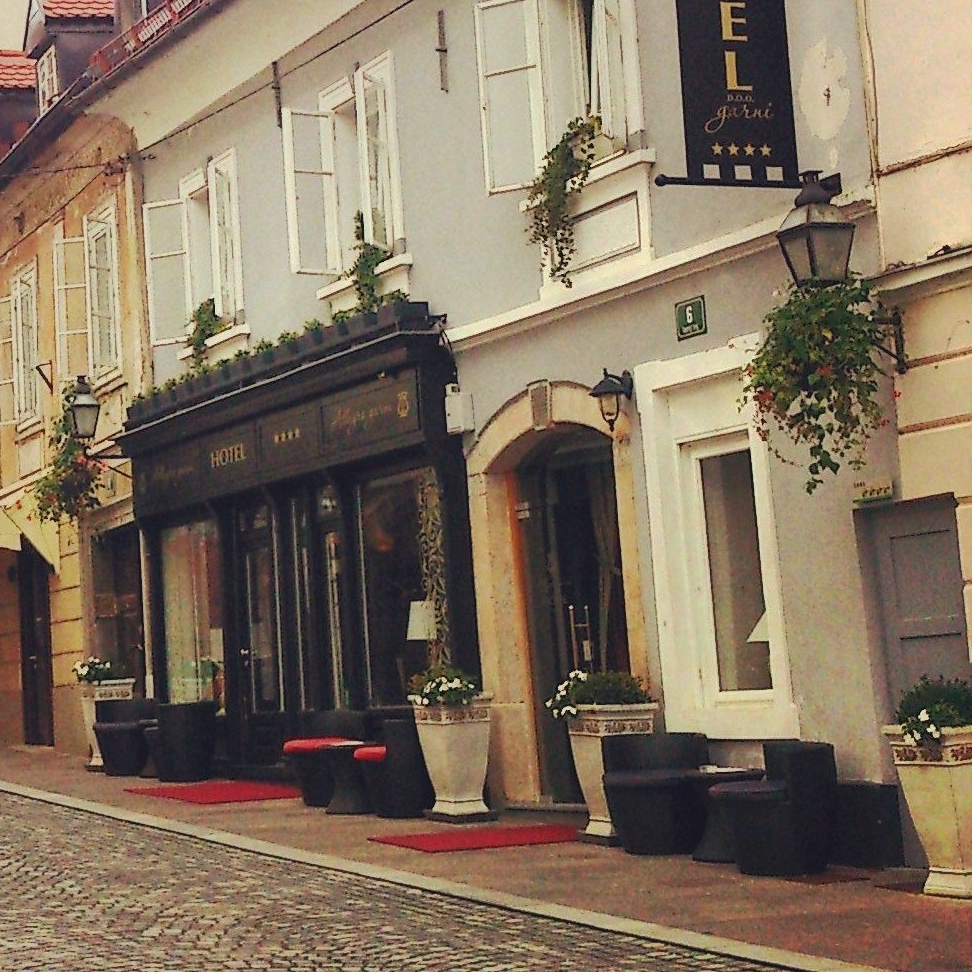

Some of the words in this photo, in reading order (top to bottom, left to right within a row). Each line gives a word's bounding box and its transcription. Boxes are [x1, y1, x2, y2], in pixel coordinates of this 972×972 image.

[704, 102, 774, 134] garni
[685, 305, 694, 324] 6
[210, 443, 247, 469] HOTEL
